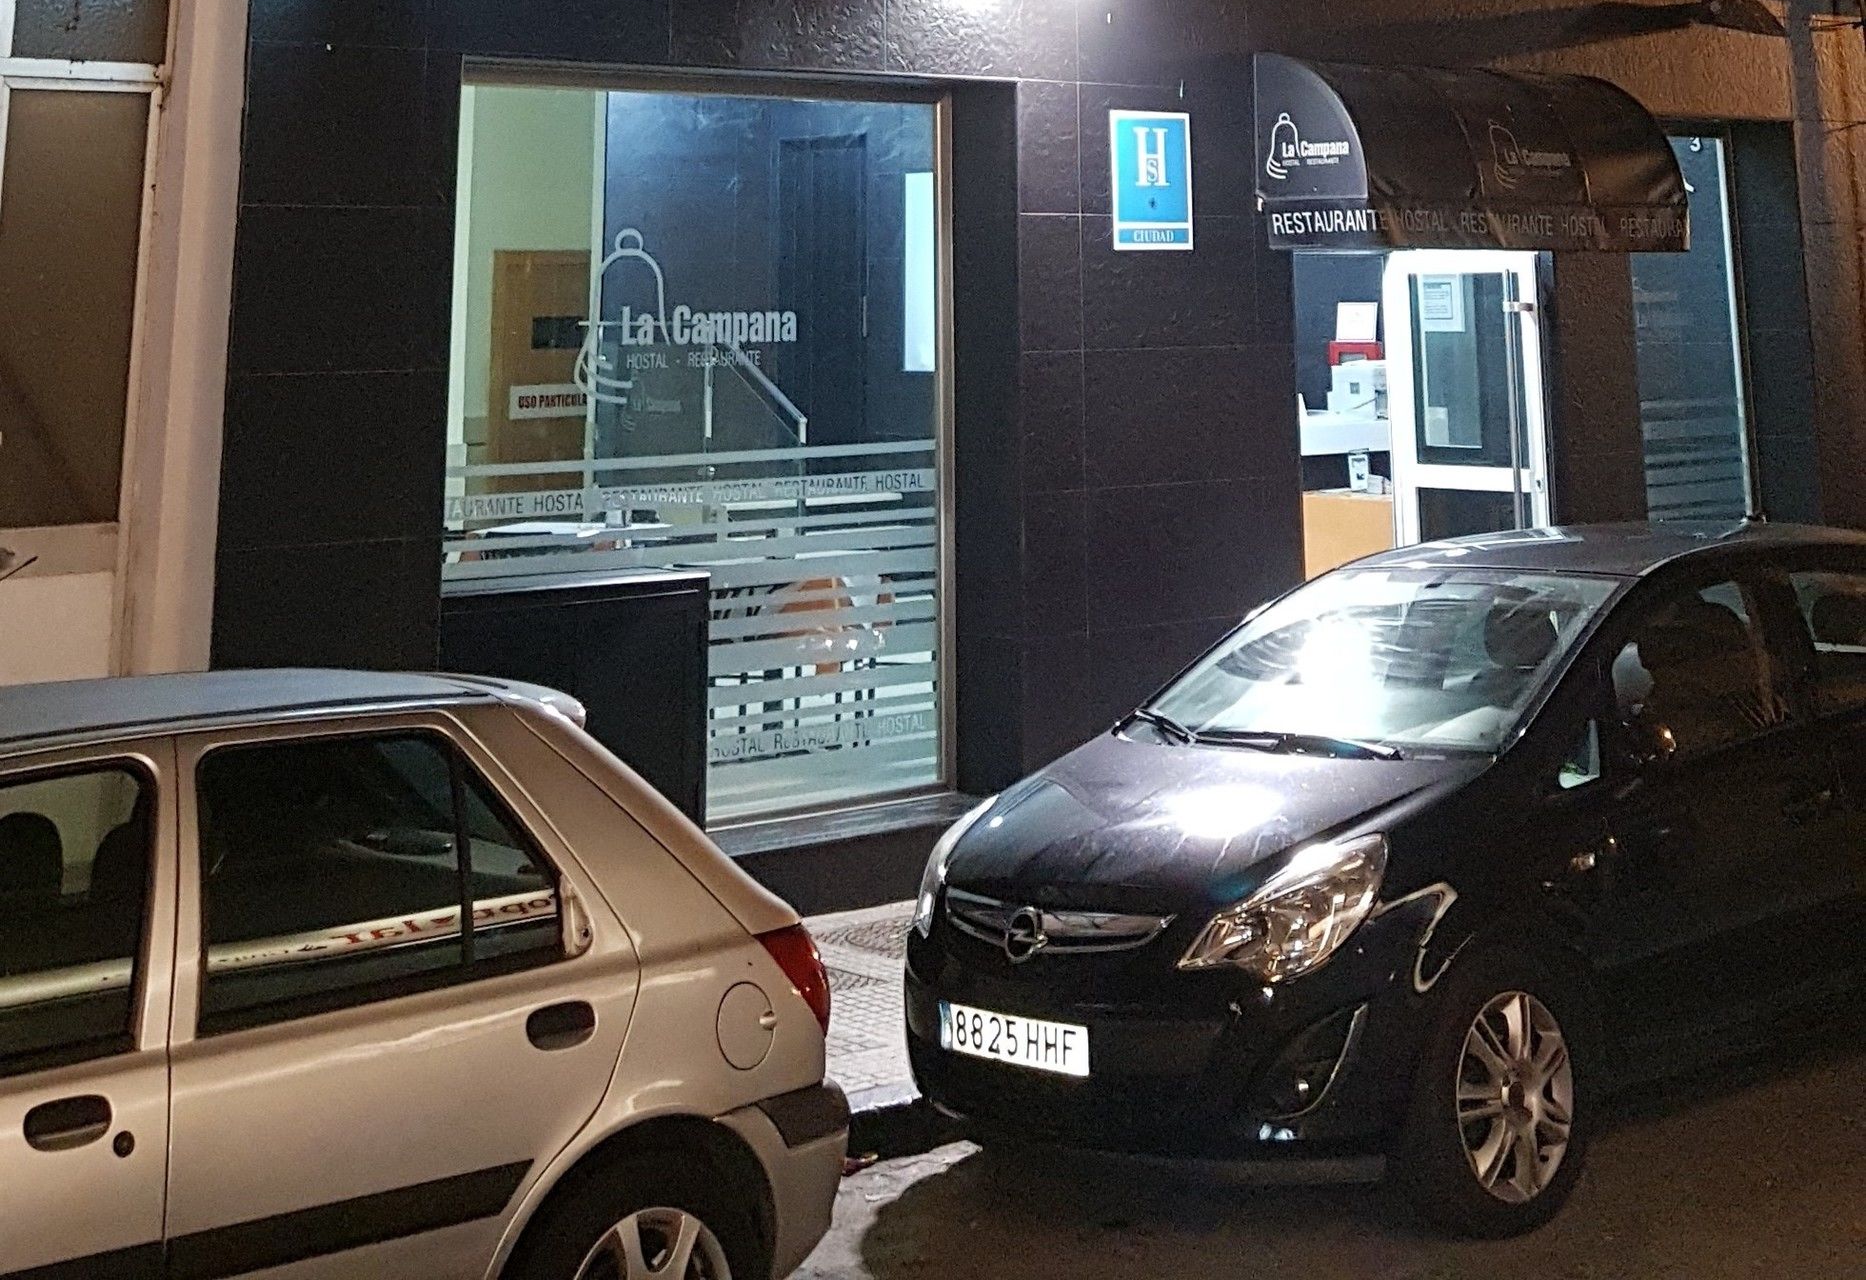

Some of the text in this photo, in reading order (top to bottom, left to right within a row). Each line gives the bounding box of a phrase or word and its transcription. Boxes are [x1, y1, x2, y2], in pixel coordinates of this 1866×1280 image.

[1282, 141, 1350, 159] La Campana
[1272, 208, 1389, 236] RESTAURANTE
[1133, 229, 1175, 243] CIUDAD
[622, 304, 798, 352] La Campana
[626, 351, 669, 370] HOSTAL
[518, 393, 588, 409] USO PARTICULA
[533, 493, 584, 514] HOSTA
[875, 473, 925, 491] HOSTAL
[956, 1010, 1077, 1066] 8825 HHF
